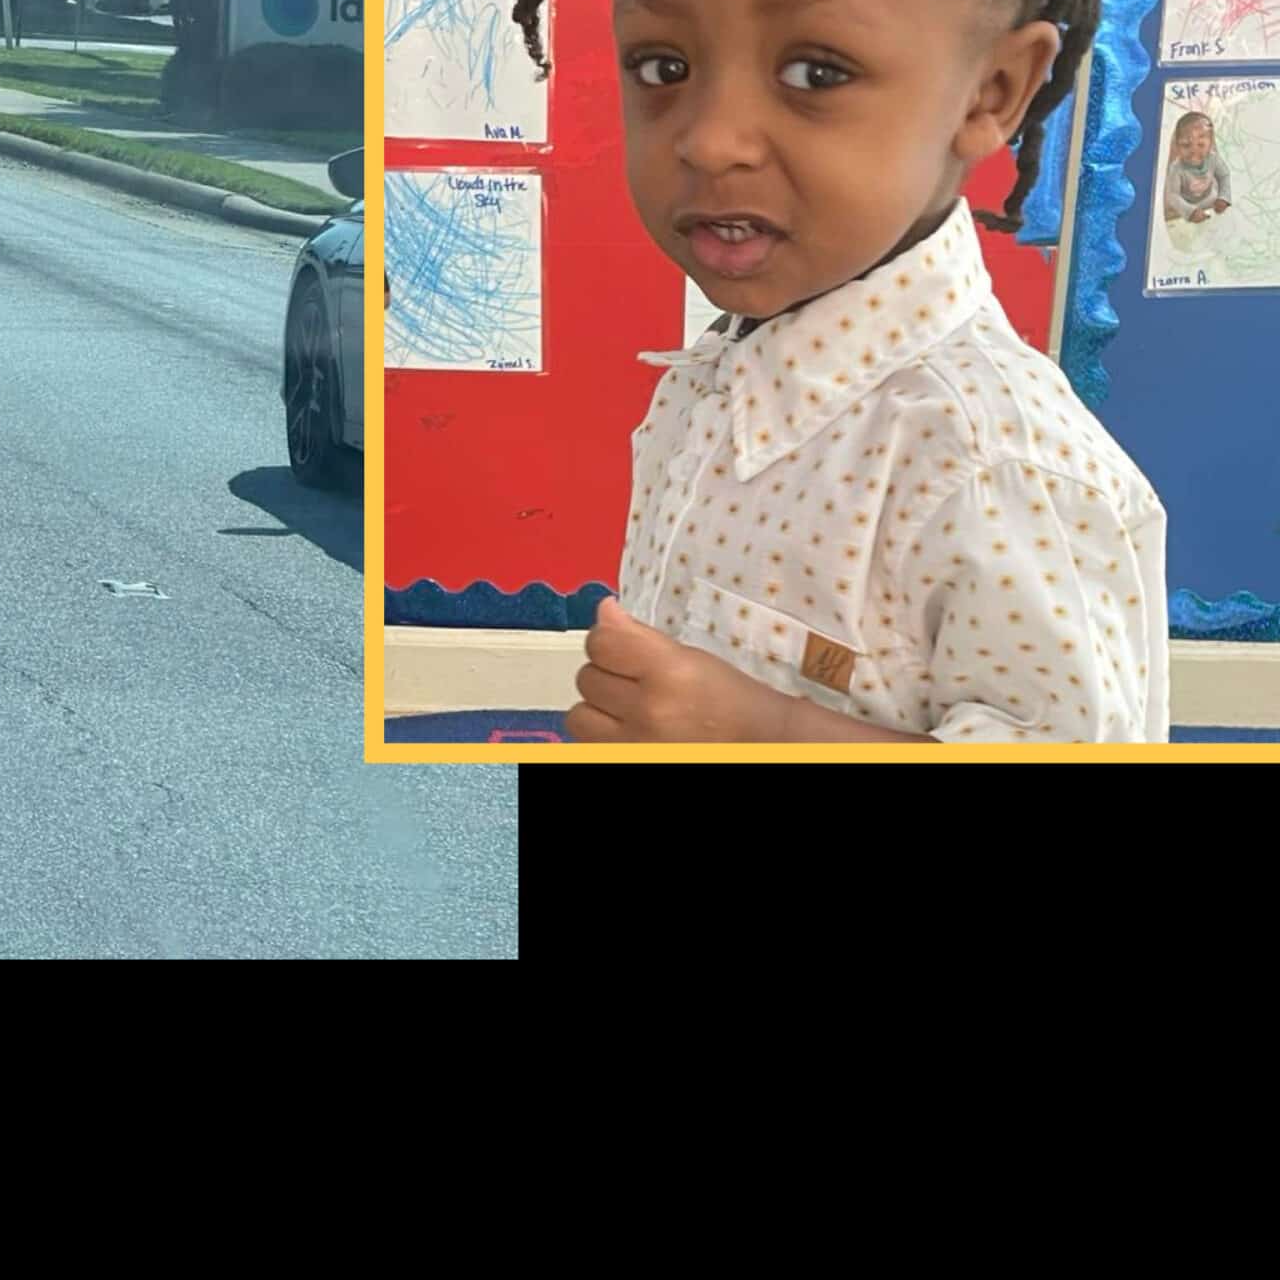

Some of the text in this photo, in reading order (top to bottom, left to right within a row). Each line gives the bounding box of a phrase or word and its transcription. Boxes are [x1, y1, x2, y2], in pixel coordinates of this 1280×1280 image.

[1170, 41, 1211, 59] Frank
[484, 123, 508, 138] Ava
[474, 193, 502, 214] Sky
